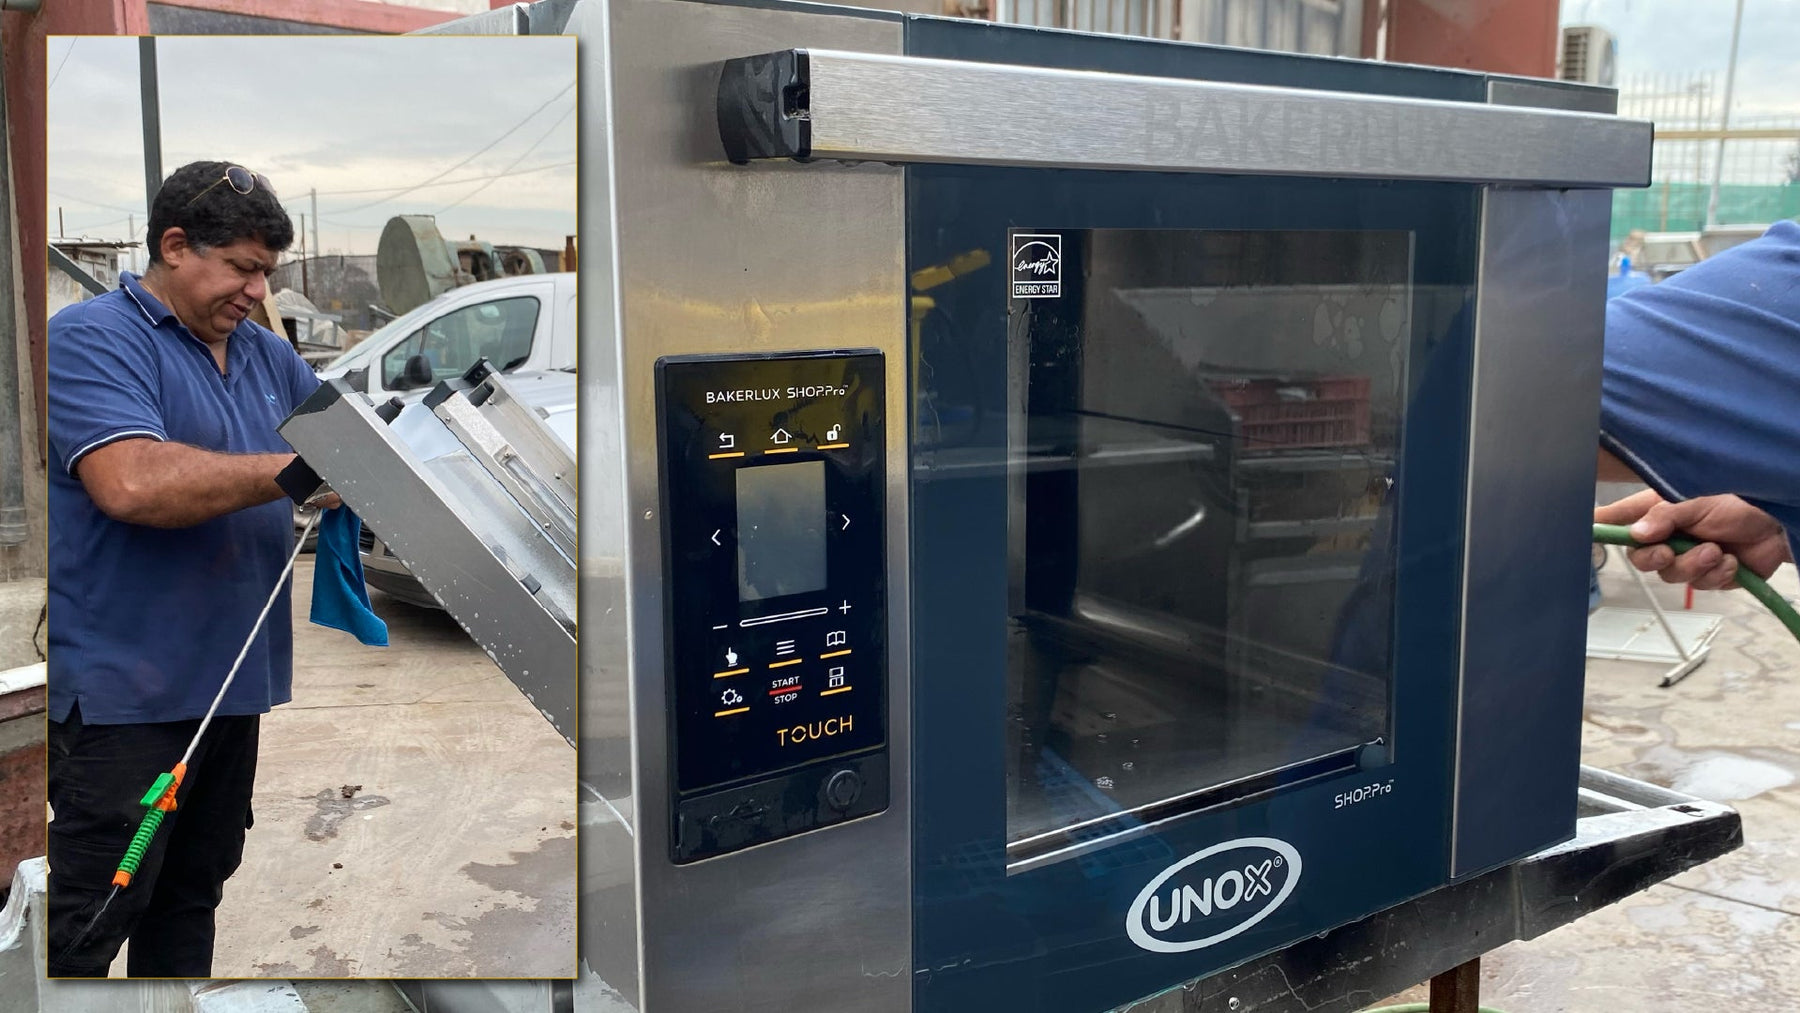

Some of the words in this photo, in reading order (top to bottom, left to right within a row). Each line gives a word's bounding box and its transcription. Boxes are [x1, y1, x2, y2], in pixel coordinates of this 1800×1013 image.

[1145, 97, 1459, 172] BAKERLUX
[1015, 260, 1046, 275] energy
[1015, 285, 1041, 294] ENERGY
[1041, 285, 1058, 294] STAR
[706, 388, 780, 403] BAKERLUX
[772, 676, 799, 688] START
[774, 693, 798, 704] STOP
[777, 715, 853, 746] TOUCH
[1150, 859, 1273, 932] UNOX
